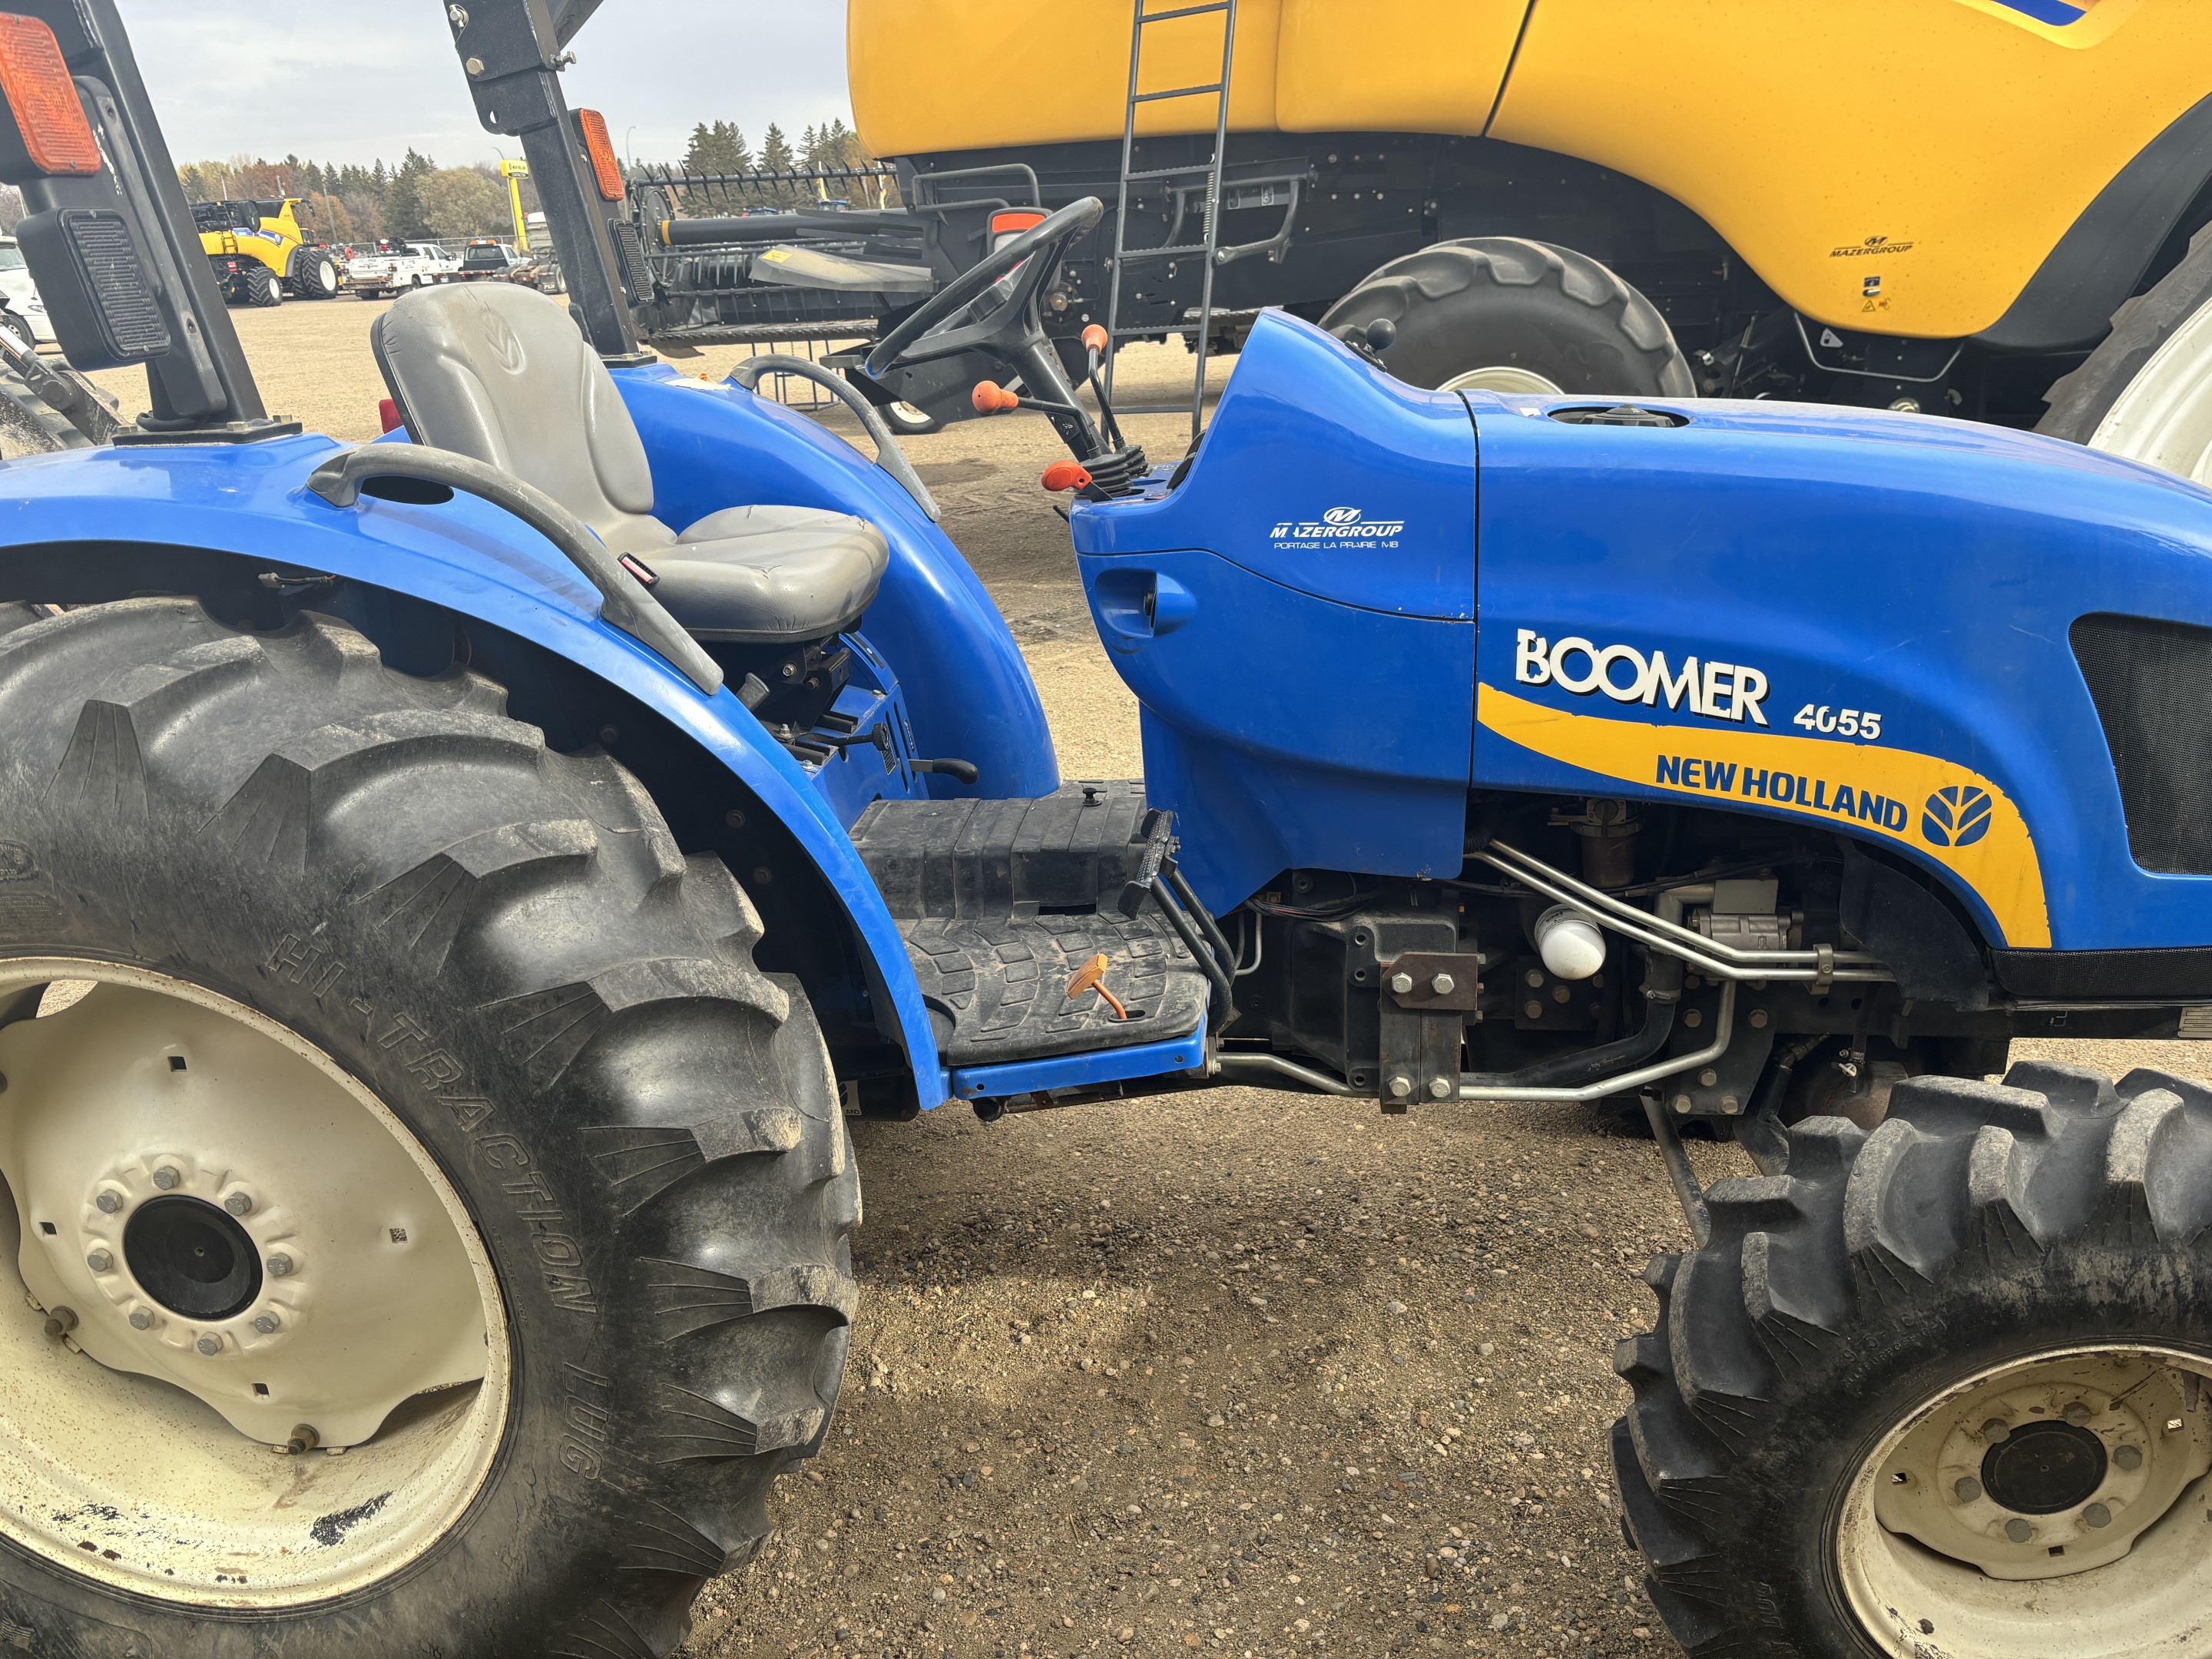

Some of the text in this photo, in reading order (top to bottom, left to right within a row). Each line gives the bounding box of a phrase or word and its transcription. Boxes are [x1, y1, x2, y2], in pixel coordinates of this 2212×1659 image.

[1829, 245, 1913, 257] MAZERGROUP
[1515, 628, 1770, 727] BOOMER
[1793, 704, 1882, 740] 4055
[1656, 754, 1908, 833] NEW HOLLAND
[559, 1362, 608, 1479] LUG
